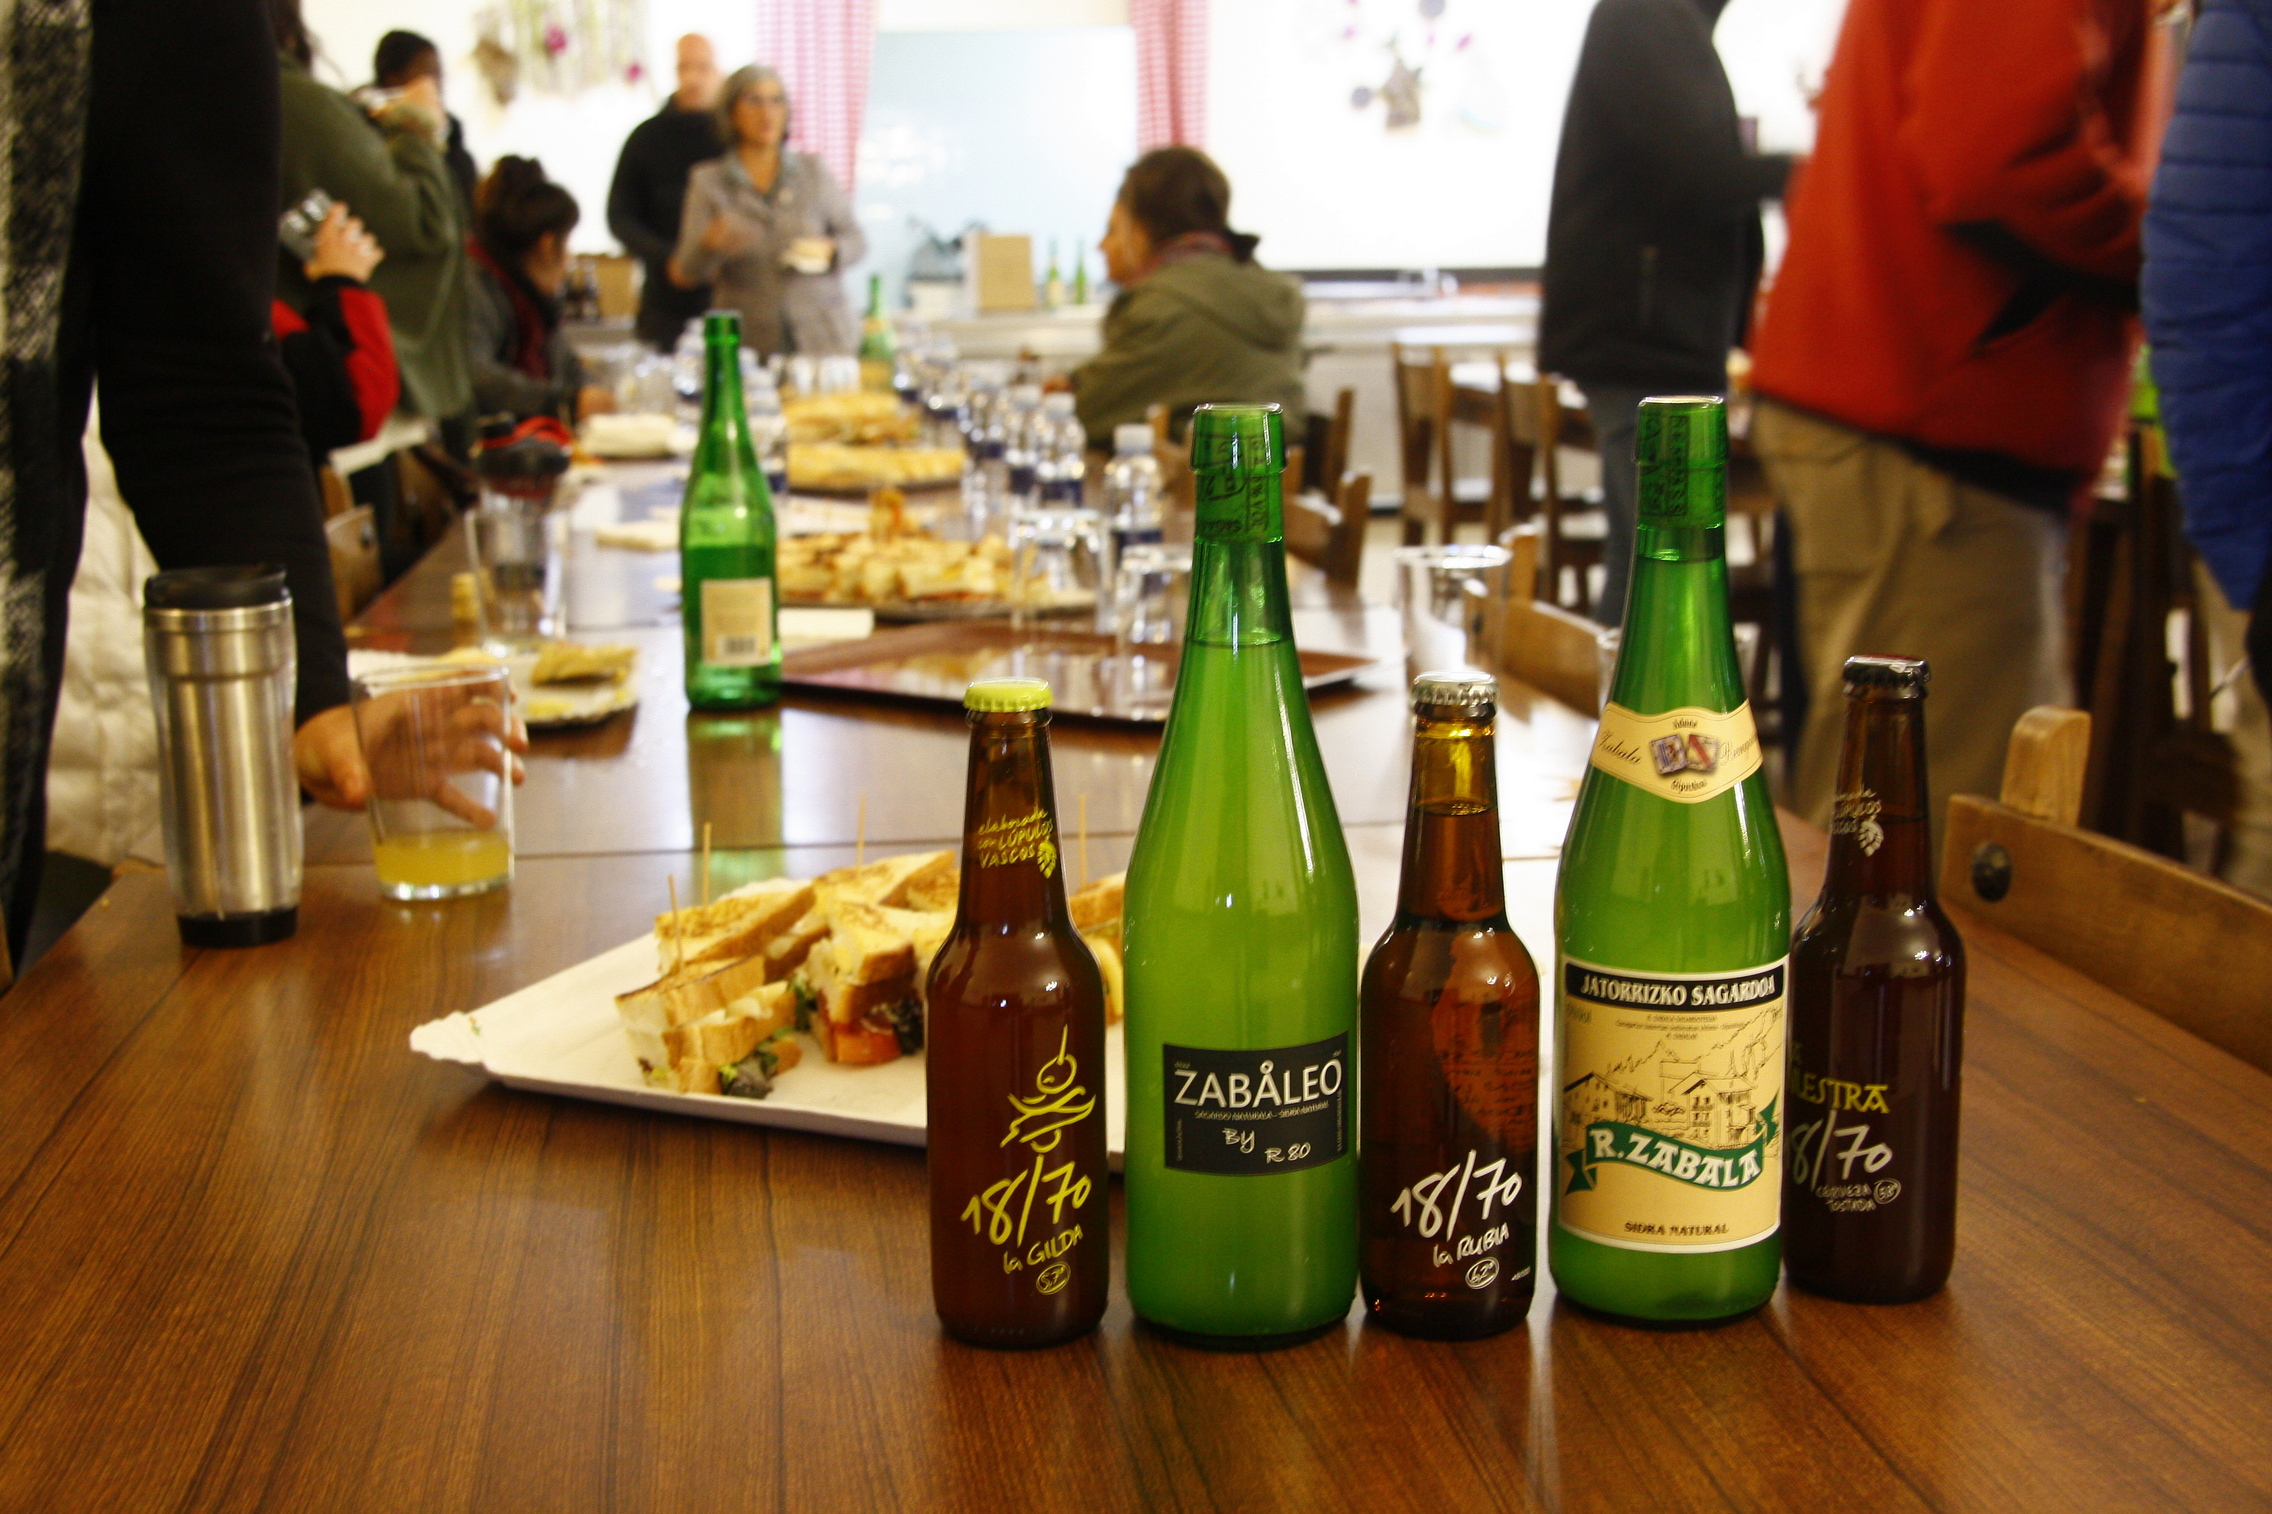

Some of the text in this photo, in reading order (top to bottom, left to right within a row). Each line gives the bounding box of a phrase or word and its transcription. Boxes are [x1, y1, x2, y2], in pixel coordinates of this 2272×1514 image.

[980, 843, 1036, 869] VASCOS
[1580, 974, 1776, 1007] JATORRIZKO SAGARDOA
[1791, 1109, 1893, 1193] 8/70
[960, 1154, 1093, 1248] 18/70
[1389, 1149, 1523, 1243] 18/70
[1027, 1223, 1083, 1266] GILDA
[1456, 1222, 1510, 1261] RUBIA
[1624, 1222, 1730, 1237] SIDRA NATURAL
